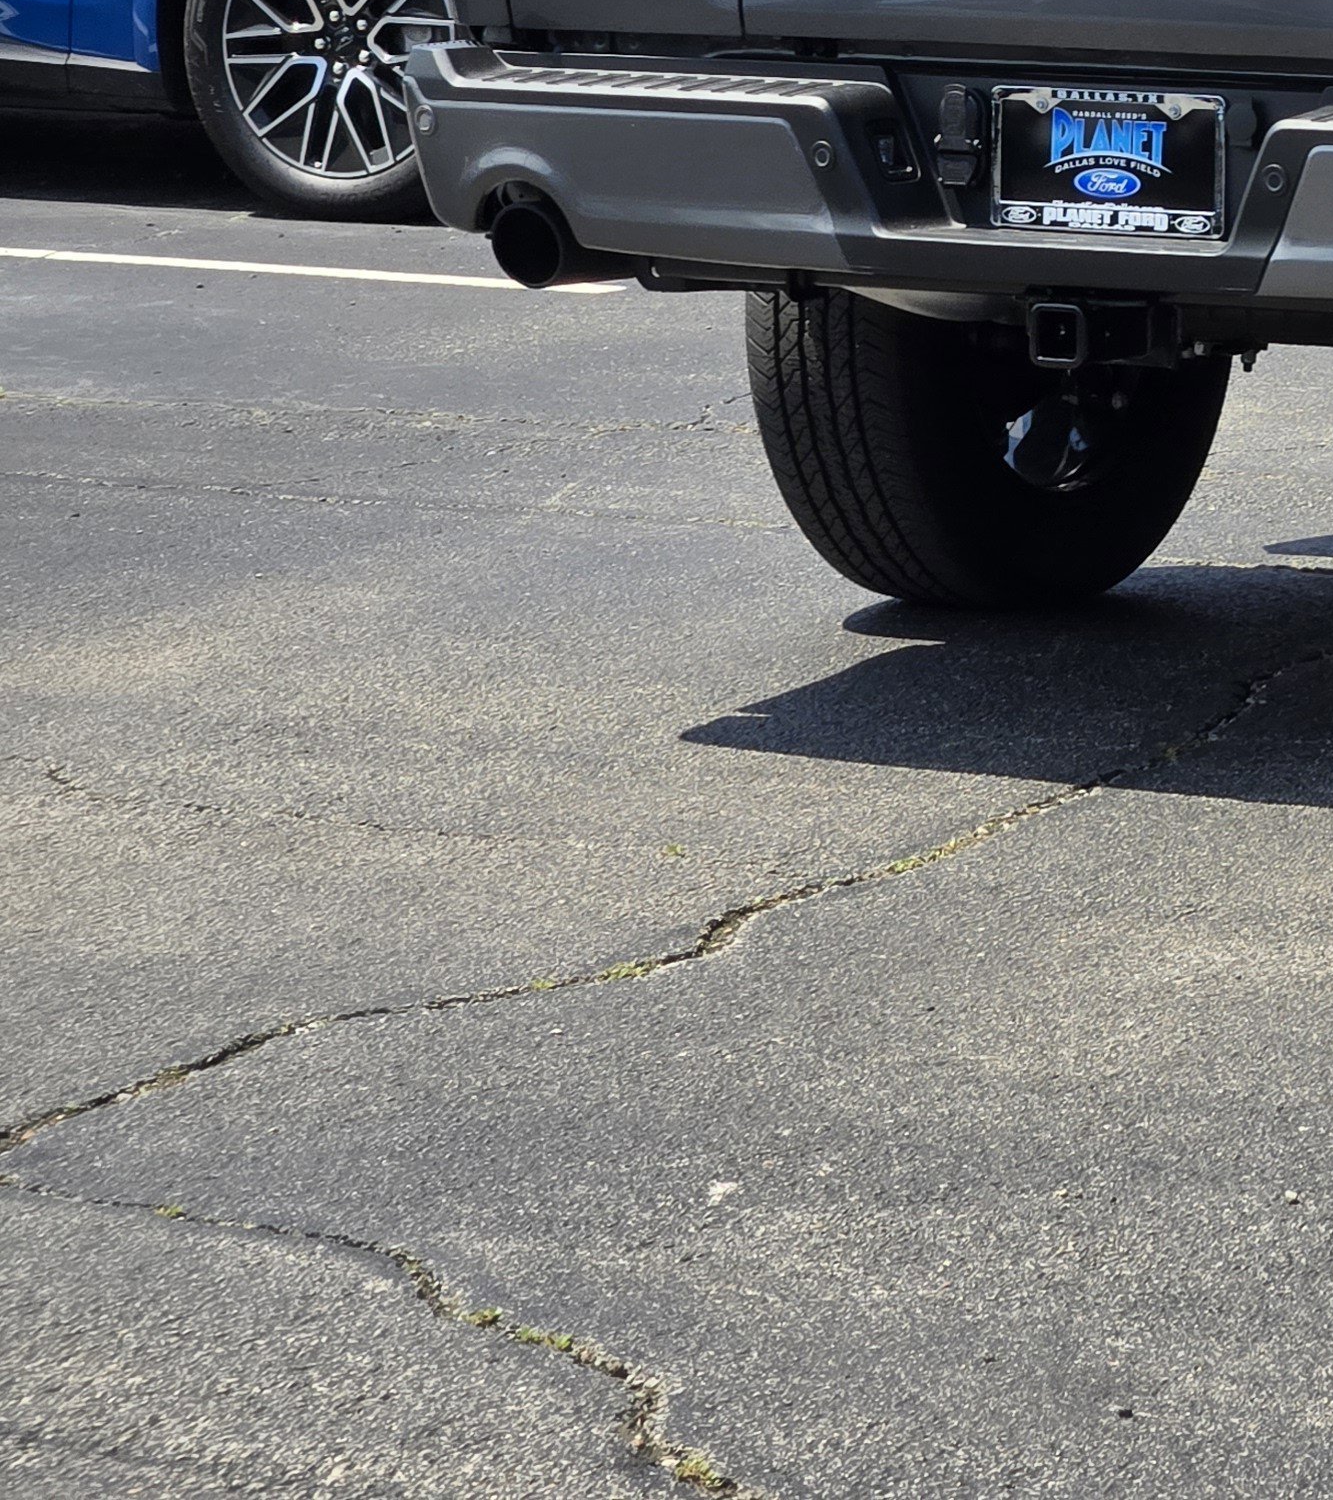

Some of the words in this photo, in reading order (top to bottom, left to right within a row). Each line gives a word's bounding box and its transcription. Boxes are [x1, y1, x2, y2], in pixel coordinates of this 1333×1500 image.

[1051, 107, 1167, 167] PLANET
[1054, 157, 1096, 174] DALLAS
[1099, 157, 1127, 167] LOVE
[1130, 161, 1162, 178] FIELD
[1087, 171, 1128, 194] Ford
[1042, 206, 1114, 226] PLANET
[1118, 211, 1169, 232] FORD
